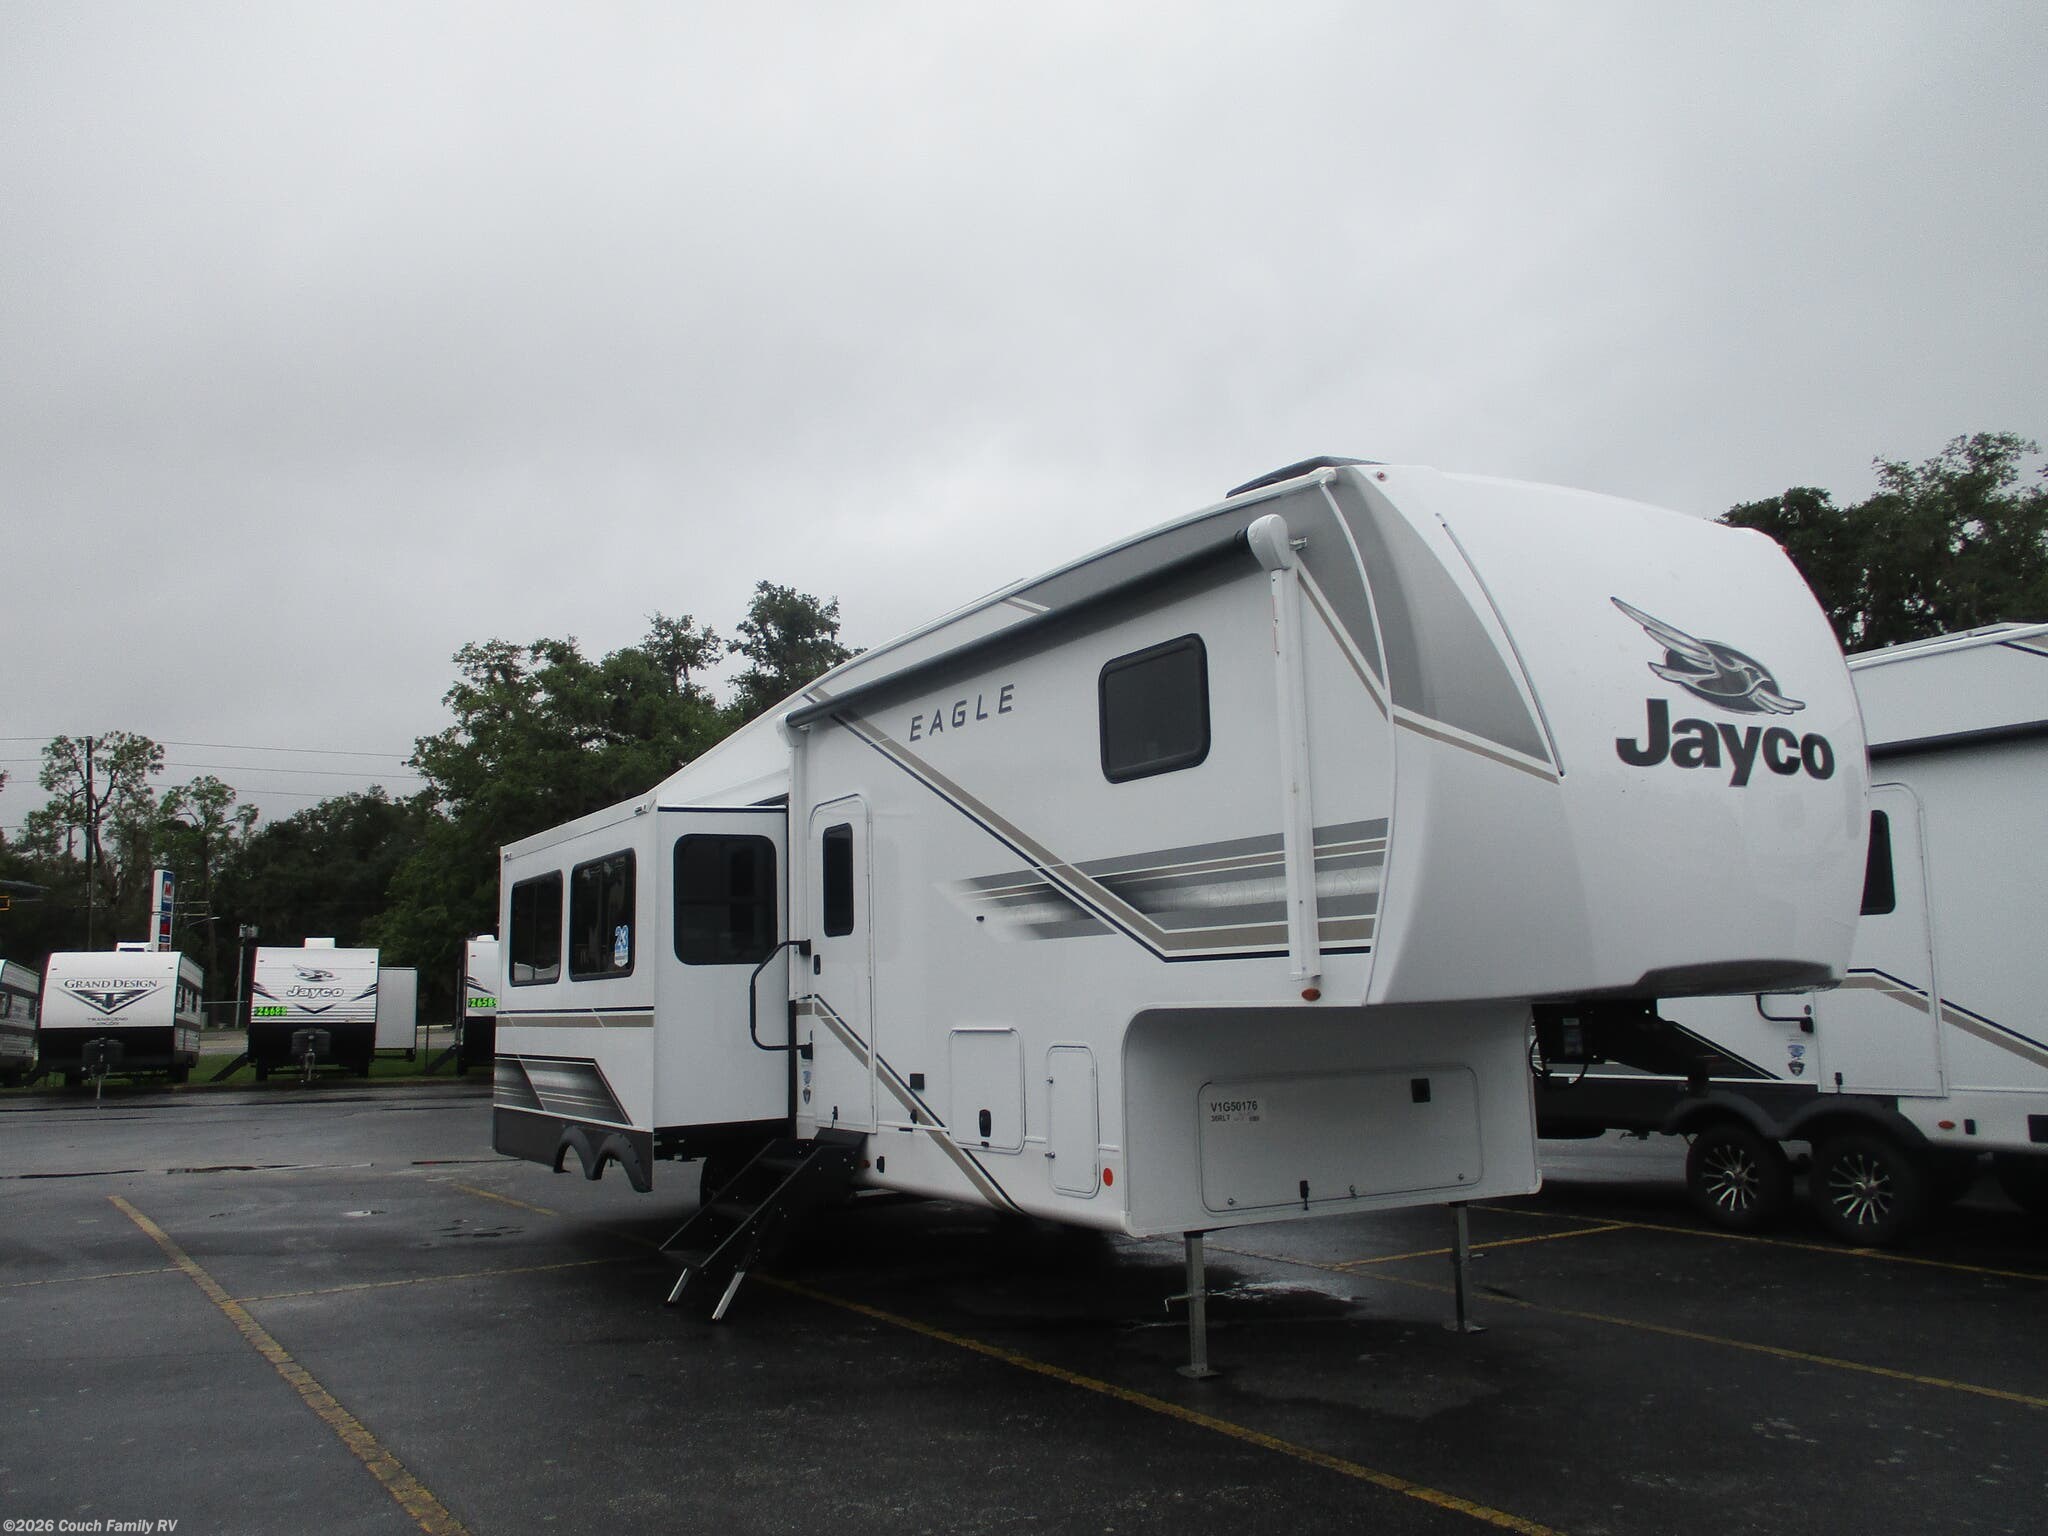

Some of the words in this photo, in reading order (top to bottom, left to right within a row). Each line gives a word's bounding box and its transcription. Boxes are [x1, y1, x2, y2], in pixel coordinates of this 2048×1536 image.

[910, 684, 1014, 742] EAGLE
[1616, 698, 1835, 787] Jayco
[64, 980, 110, 988] GRAND
[113, 980, 157, 988] DESIGN
[287, 985, 344, 998] Jayco
[1211, 1101, 1257, 1112] V1G50176
